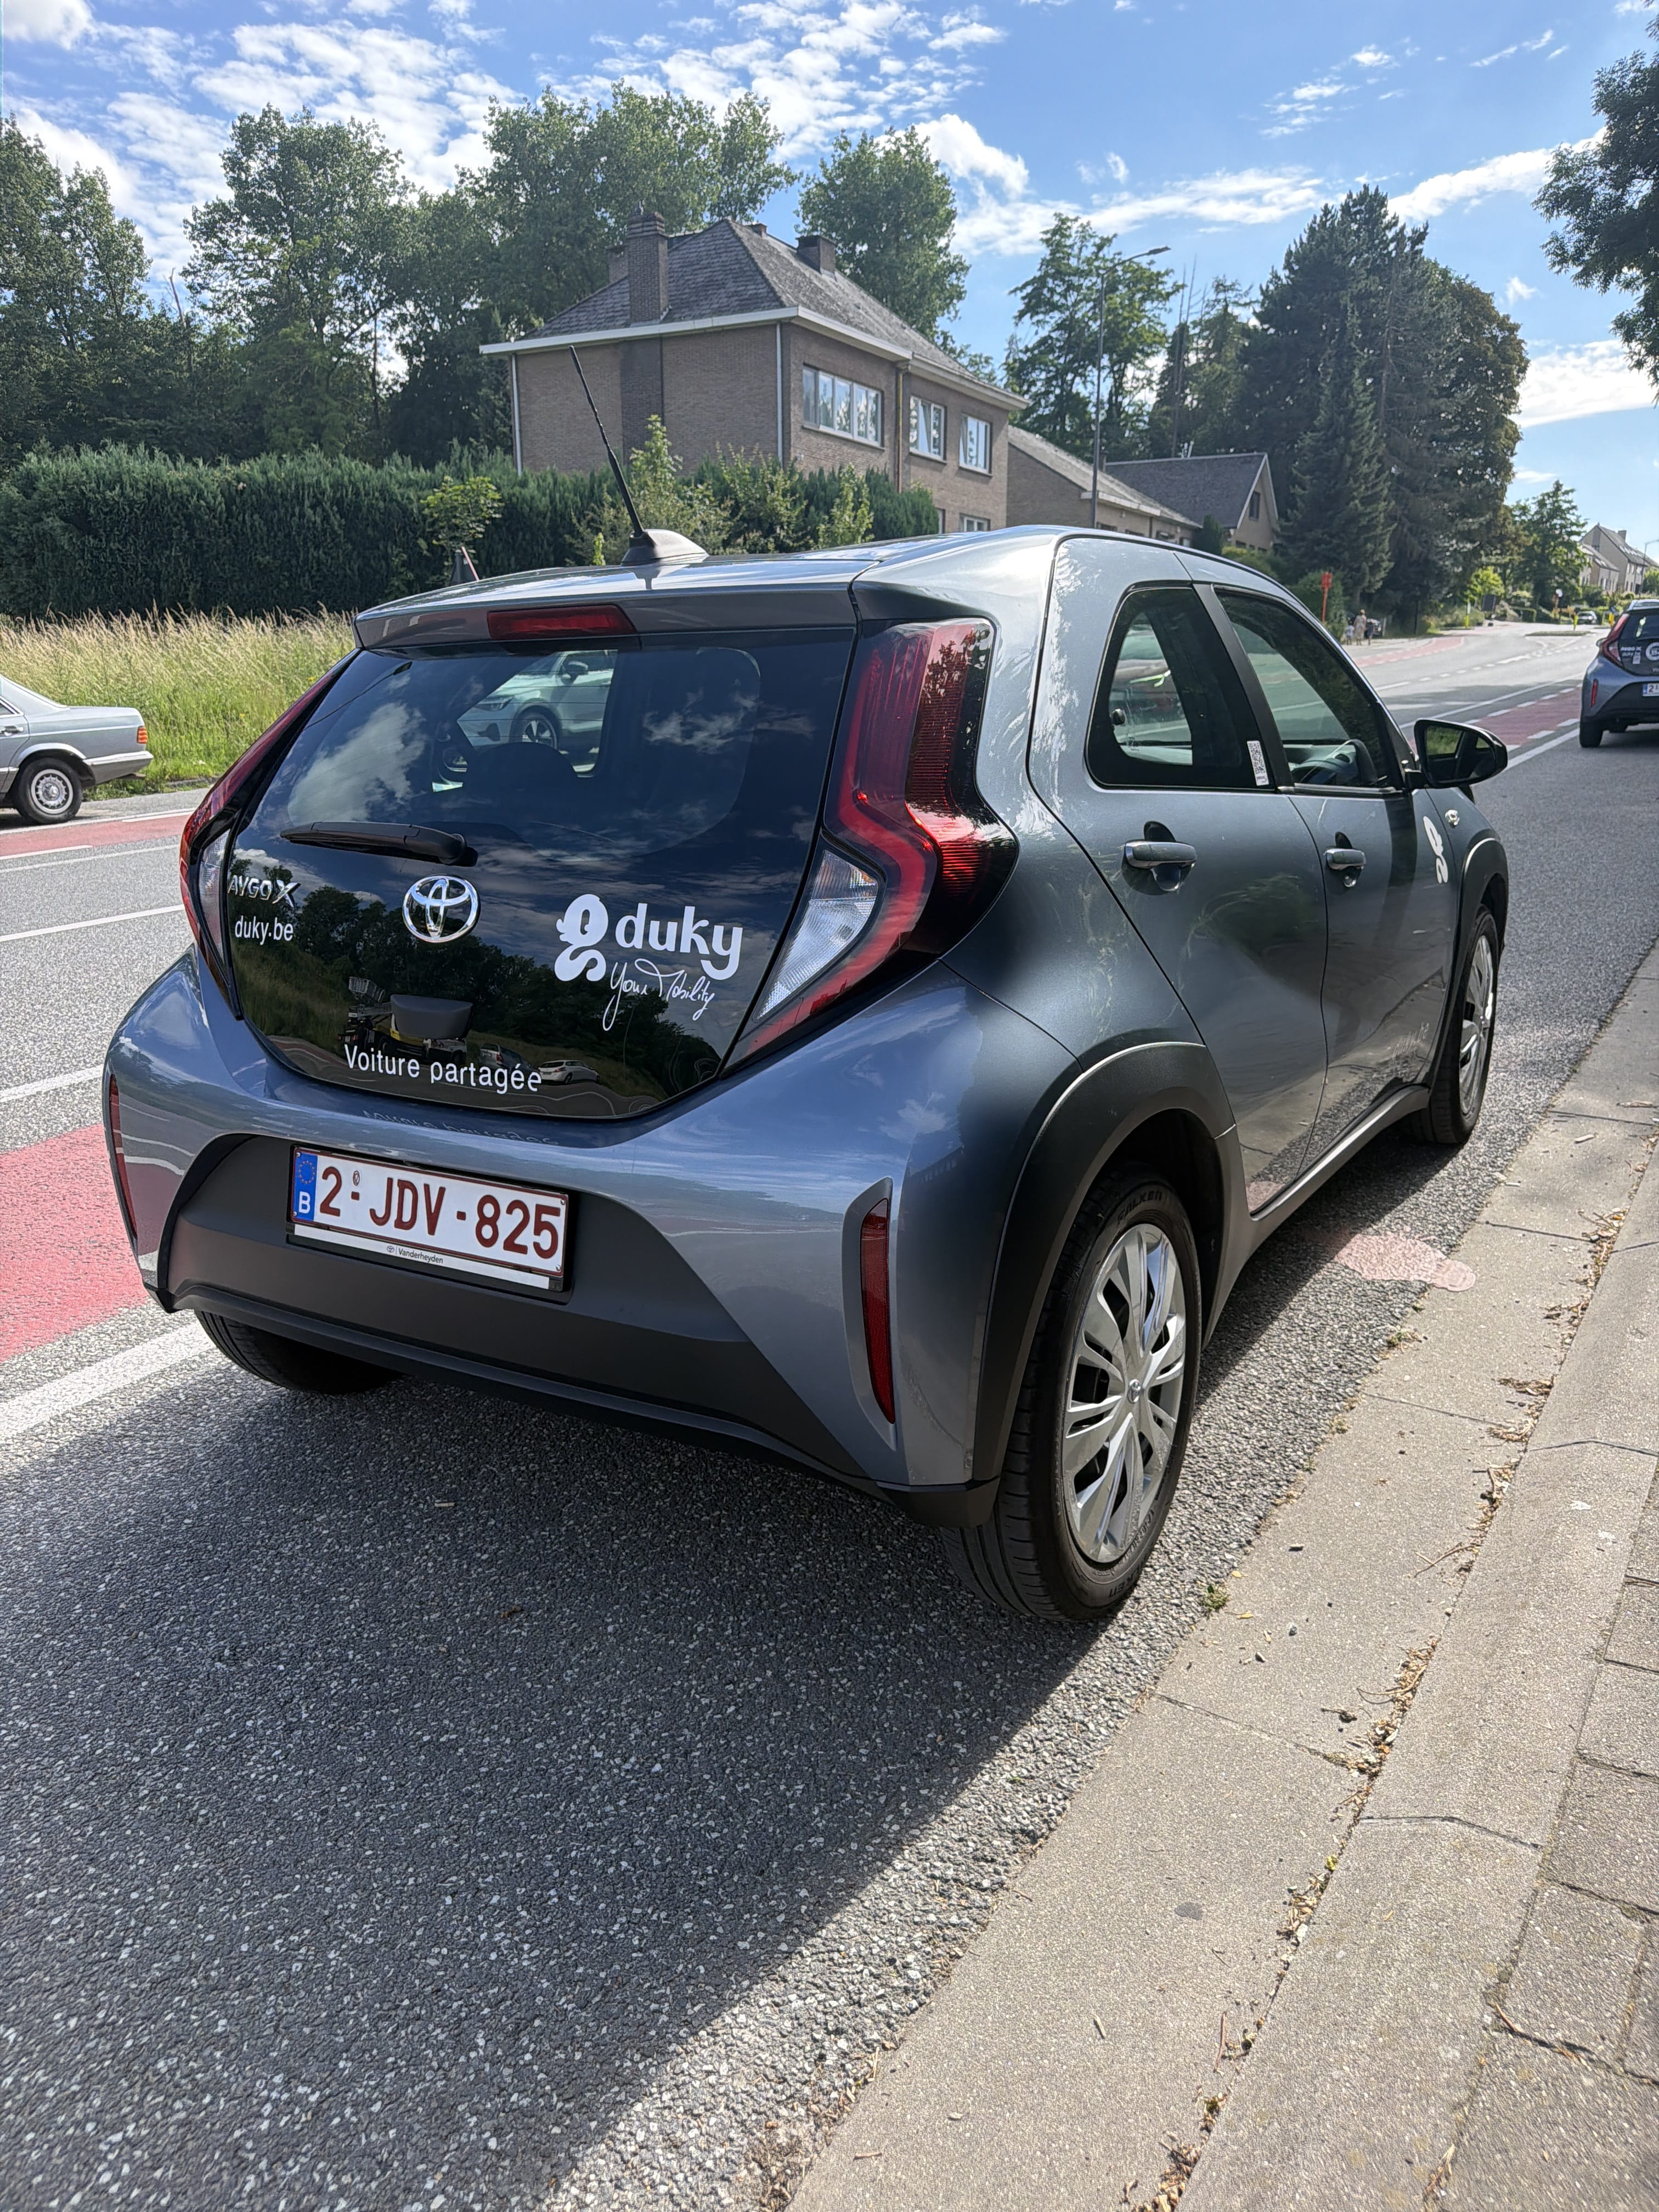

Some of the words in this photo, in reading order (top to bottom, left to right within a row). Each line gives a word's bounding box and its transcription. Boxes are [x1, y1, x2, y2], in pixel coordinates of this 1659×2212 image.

[227, 875, 273, 901] AYGO
[272, 879, 301, 908] X
[235, 915, 294, 946] duky.be
[615, 902, 743, 980] duky
[344, 1044, 420, 1079] Voiture
[430, 1063, 542, 1095] partagée
[298, 1191, 311, 1214] B
[398, 1248, 443, 1265] Vanderheyden
